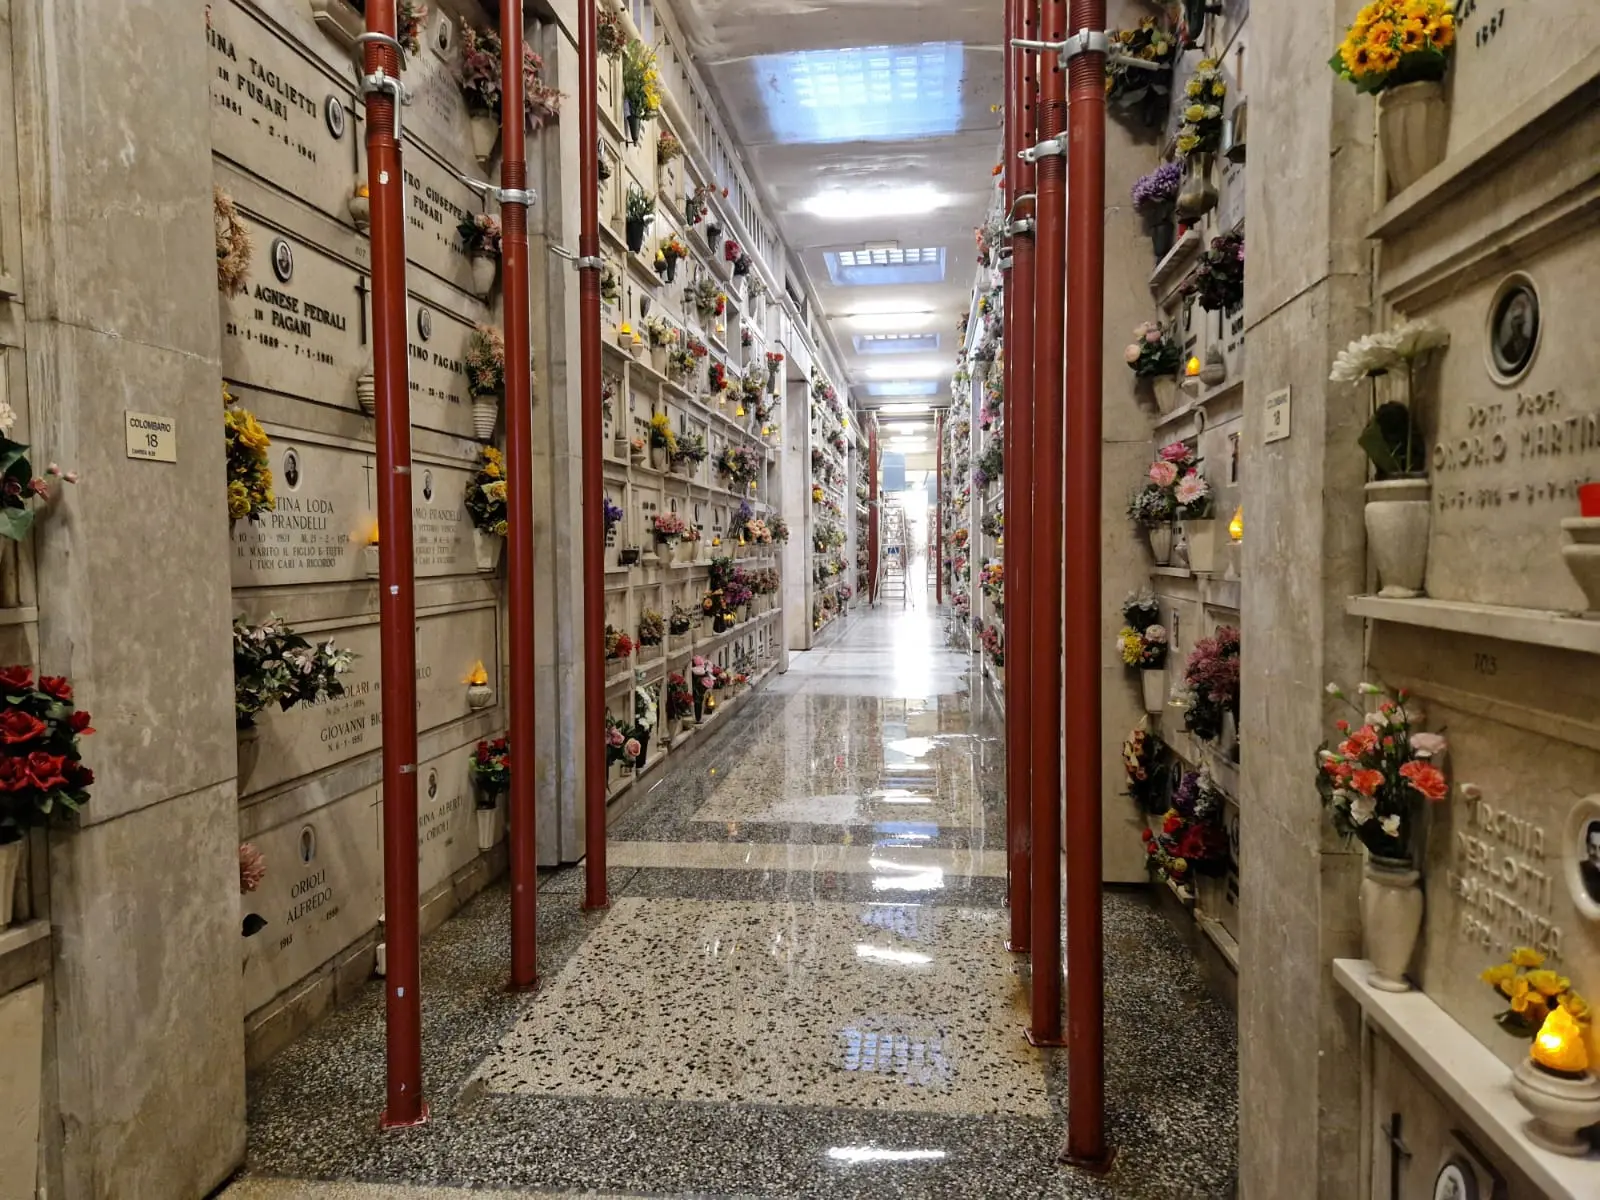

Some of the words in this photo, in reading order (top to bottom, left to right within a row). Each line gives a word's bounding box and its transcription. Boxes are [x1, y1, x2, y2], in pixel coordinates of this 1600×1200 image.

[237, 73, 287, 121] FUSARI
[249, 57, 316, 118] TAGLIETTI
[413, 195, 443, 225] FUSARI
[254, 284, 299, 313] AGNESE
[304, 302, 346, 331] PEDRALI
[272, 310, 311, 338] PAGANI
[433, 353, 463, 375] PAGANI
[130, 418, 171, 432] COLOMBARIO
[145, 434, 158, 447] 18
[306, 498, 334, 514] LODA
[271, 515, 326, 530] PRANDELLI
[320, 717, 365, 742] GIOVANNI
[291, 869, 326, 898] ORIOLI
[287, 887, 332, 925] ALFREDO
